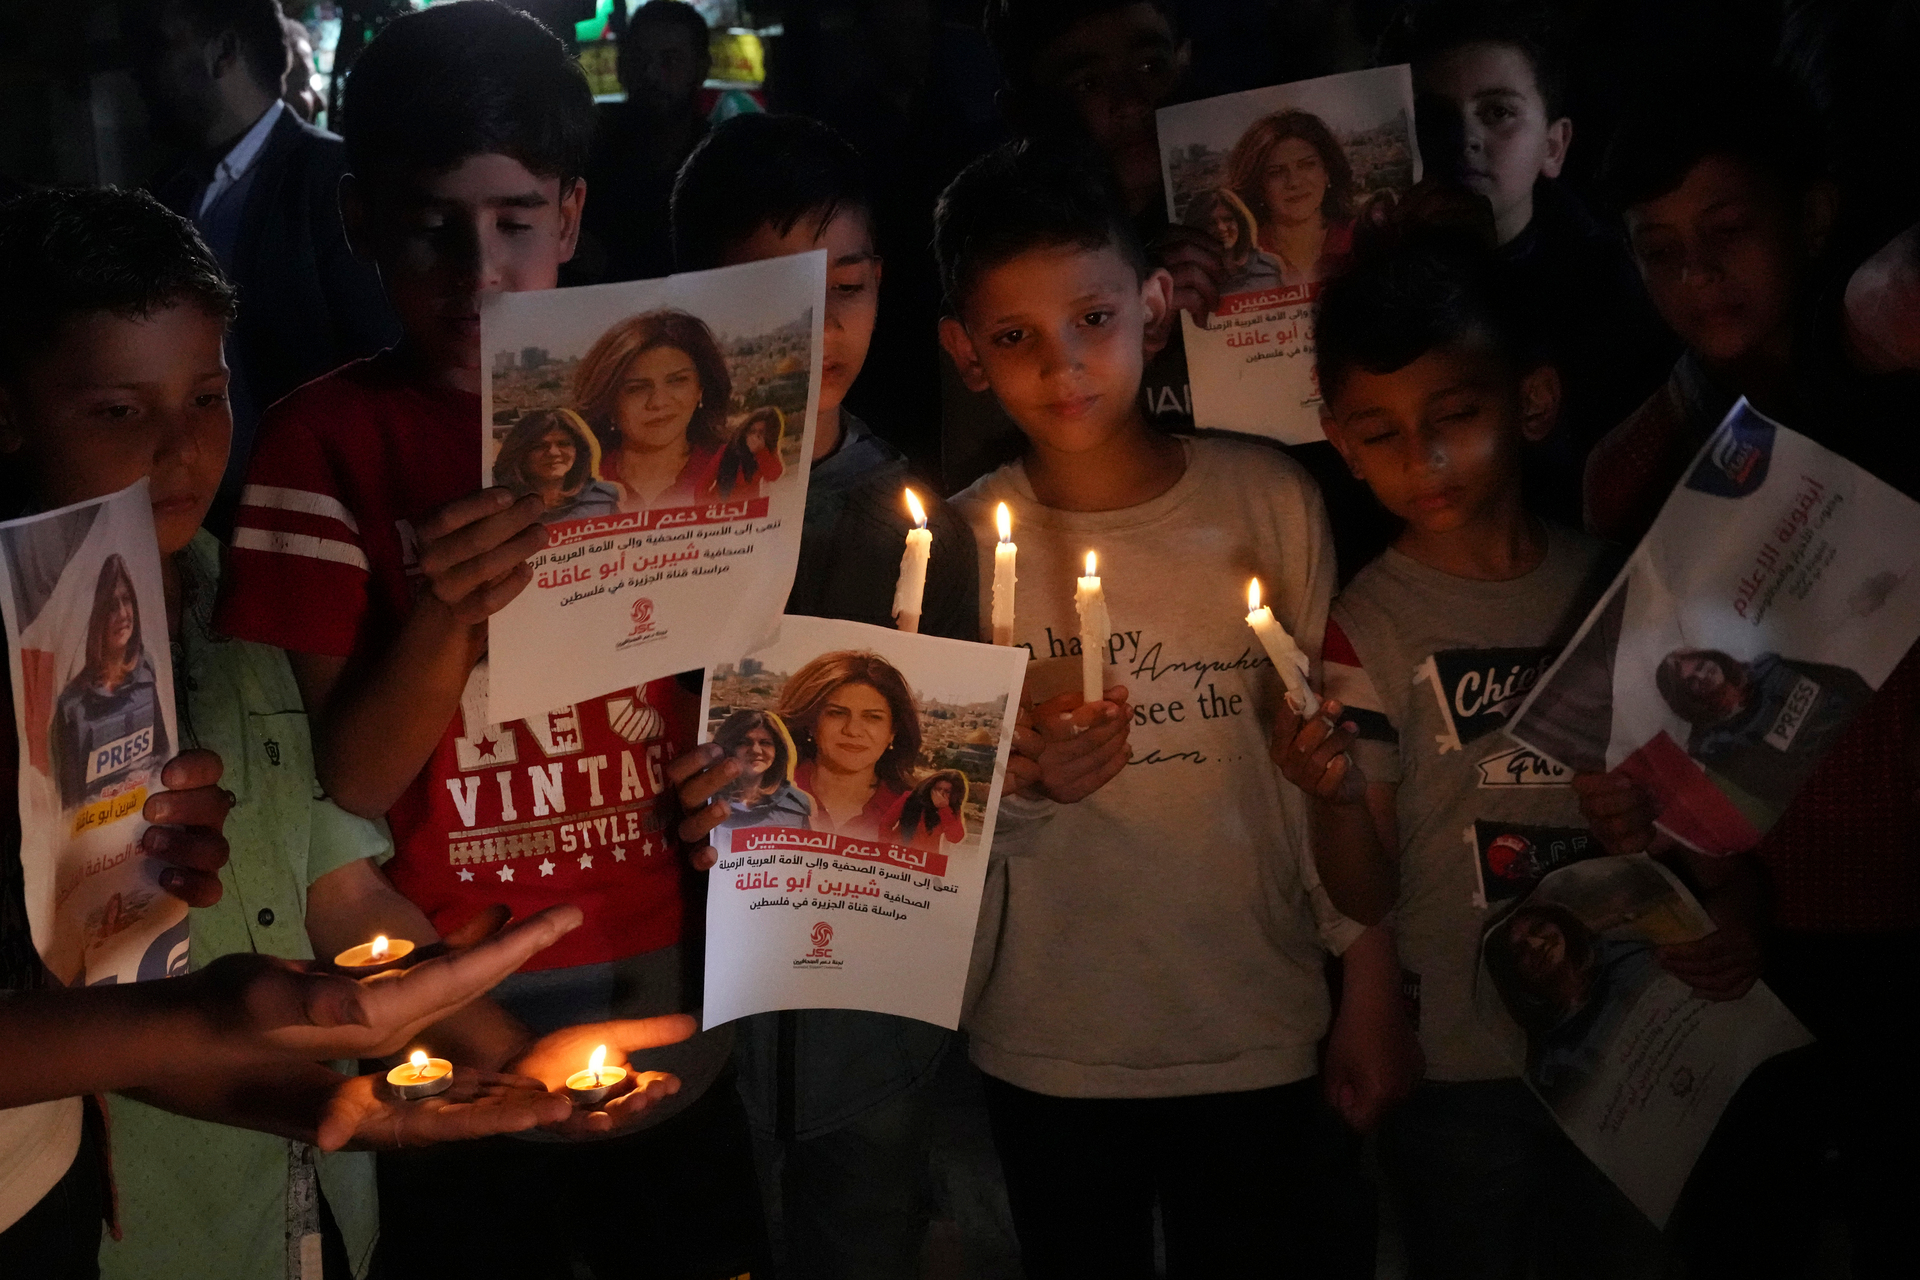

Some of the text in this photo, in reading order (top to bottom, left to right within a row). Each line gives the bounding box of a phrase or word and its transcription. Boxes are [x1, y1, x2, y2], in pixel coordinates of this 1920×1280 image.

[1230, 283, 1310, 313] الصحفيين
[1226, 329, 1271, 348] عاقلة
[1276, 321, 1298, 345] أبو
[548, 500, 748, 547] لجنة دعم الصحفيين
[1778, 475, 1824, 543] أيقونة
[588, 540, 614, 553] الأمة
[617, 538, 642, 550] وإلى
[645, 530, 693, 546] الصحفية
[696, 526, 732, 540] الأسرة
[734, 523, 753, 536] إلى
[538, 542, 754, 589] الصحافية شيرين أبو عاقلة
[550, 546, 585, 563] العربية
[560, 564, 730, 607] مراسلة قناة الجزيرة في فلسطين
[1733, 543, 1780, 619] الإعلام
[628, 621, 656, 636] JSC
[1045, 627, 1142, 665] hapy
[1130, 642, 1274, 689] Anywher
[1133, 683, 1243, 726] see the
[1773, 681, 1816, 740] PRESS
[96, 730, 150, 774] PRESS
[446, 742, 676, 828] VINTAG
[98, 800, 114, 826] أبو
[560, 812, 640, 853] STYLE
[746, 829, 928, 869] لجنة دعم الصحفيين
[86, 843, 132, 877] الصحافة
[719, 854, 959, 894] تنعى إلى الأسرة الصحفية وإلى الأمة العربية الزميلة
[735, 869, 930, 909] الصحافية شيرين أبو عاقلة
[749, 896, 907, 920] مراسلة قناة الجزيرة في فلسطين
[806, 948, 832, 957] JSC
